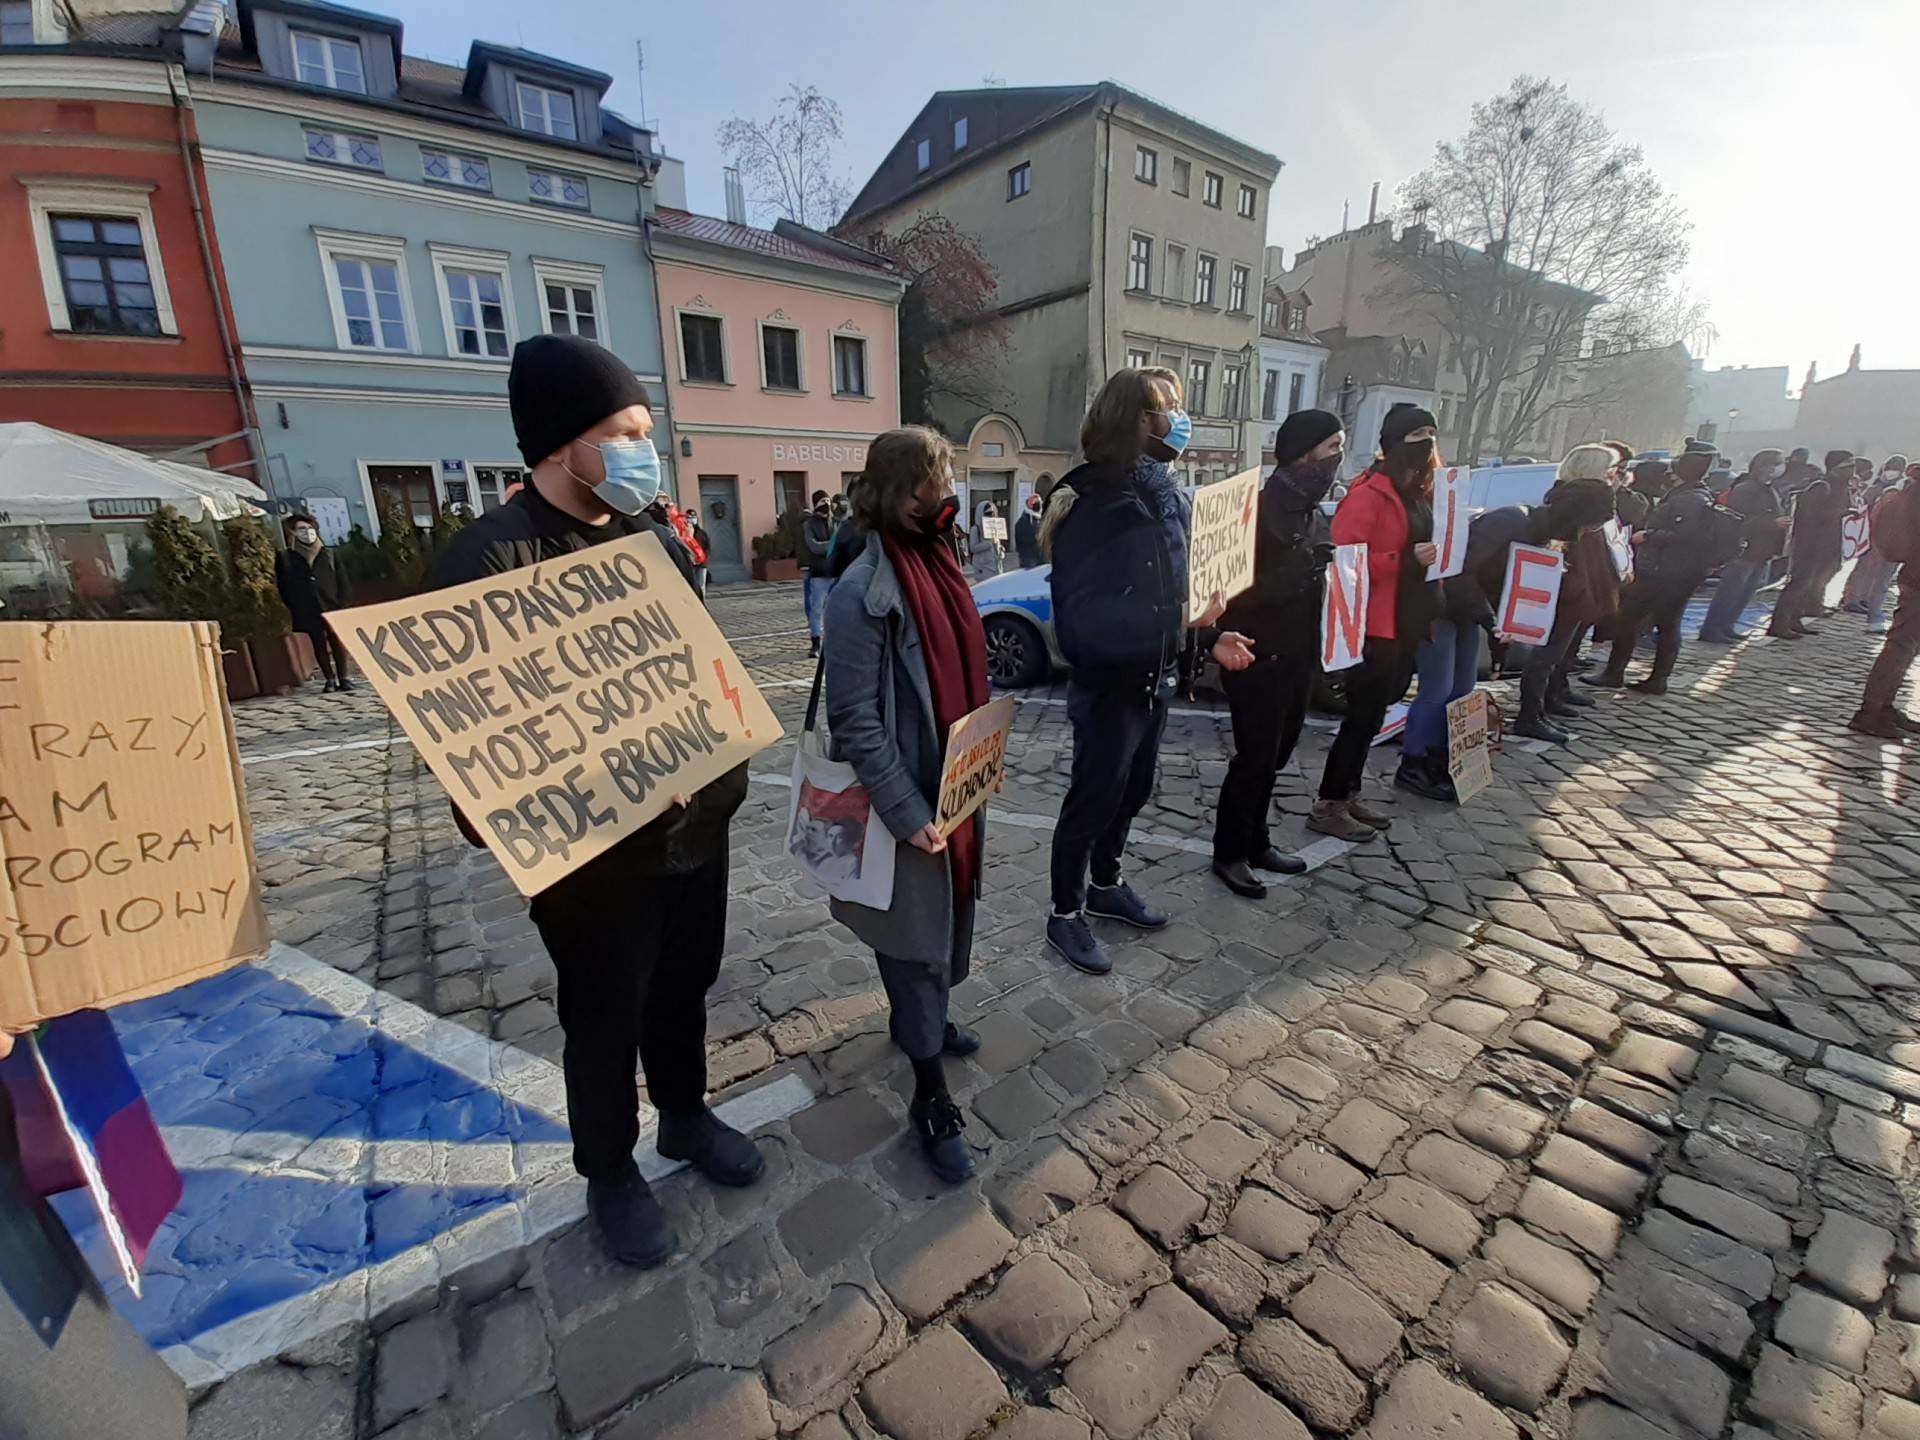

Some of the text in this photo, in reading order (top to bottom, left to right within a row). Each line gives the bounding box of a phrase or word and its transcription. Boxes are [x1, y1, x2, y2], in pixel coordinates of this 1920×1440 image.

[1195, 489, 1231, 532] NIGDY
[356, 551, 648, 683] KIEDY PAŃSTWO
[1225, 549, 1248, 588] SAMA
[1323, 551, 1364, 666] N
[1502, 549, 1559, 639] E
[406, 600, 681, 744] MNIE NIE CHRONI
[446, 644, 698, 800] MOJEJ SIOSTRY
[30, 712, 206, 761] RAZY,
[486, 691, 729, 870] BĘDĘ BRONIĆ
[5, 821, 234, 891] ROGRAM
